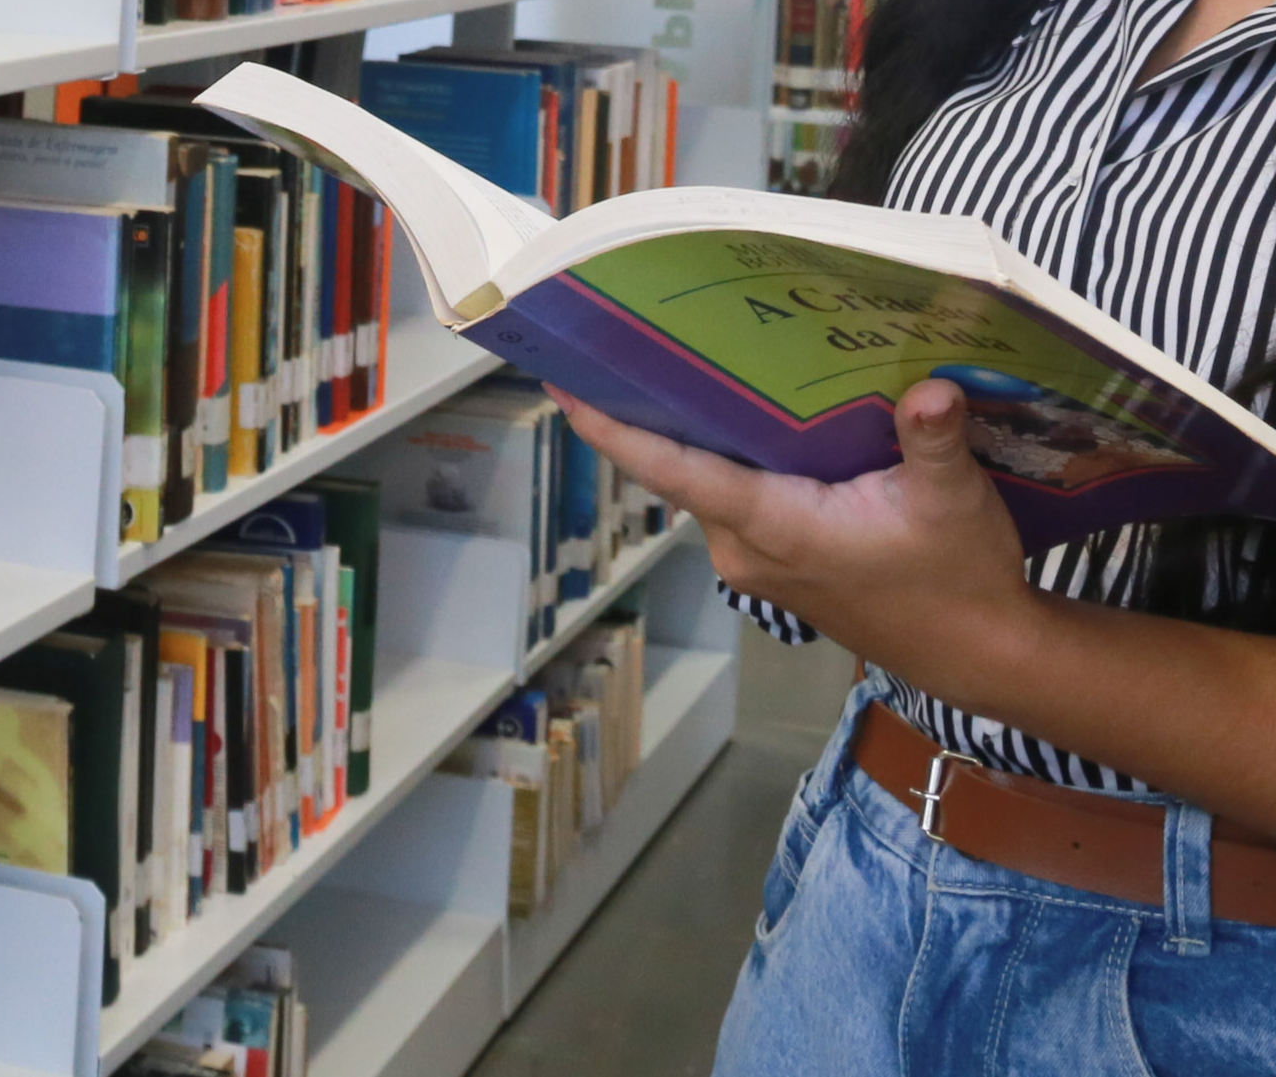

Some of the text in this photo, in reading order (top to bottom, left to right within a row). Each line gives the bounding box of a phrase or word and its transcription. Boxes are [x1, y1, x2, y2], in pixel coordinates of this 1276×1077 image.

[743, 286, 994, 327] A Criação
[825, 321, 1023, 356] da Vida
